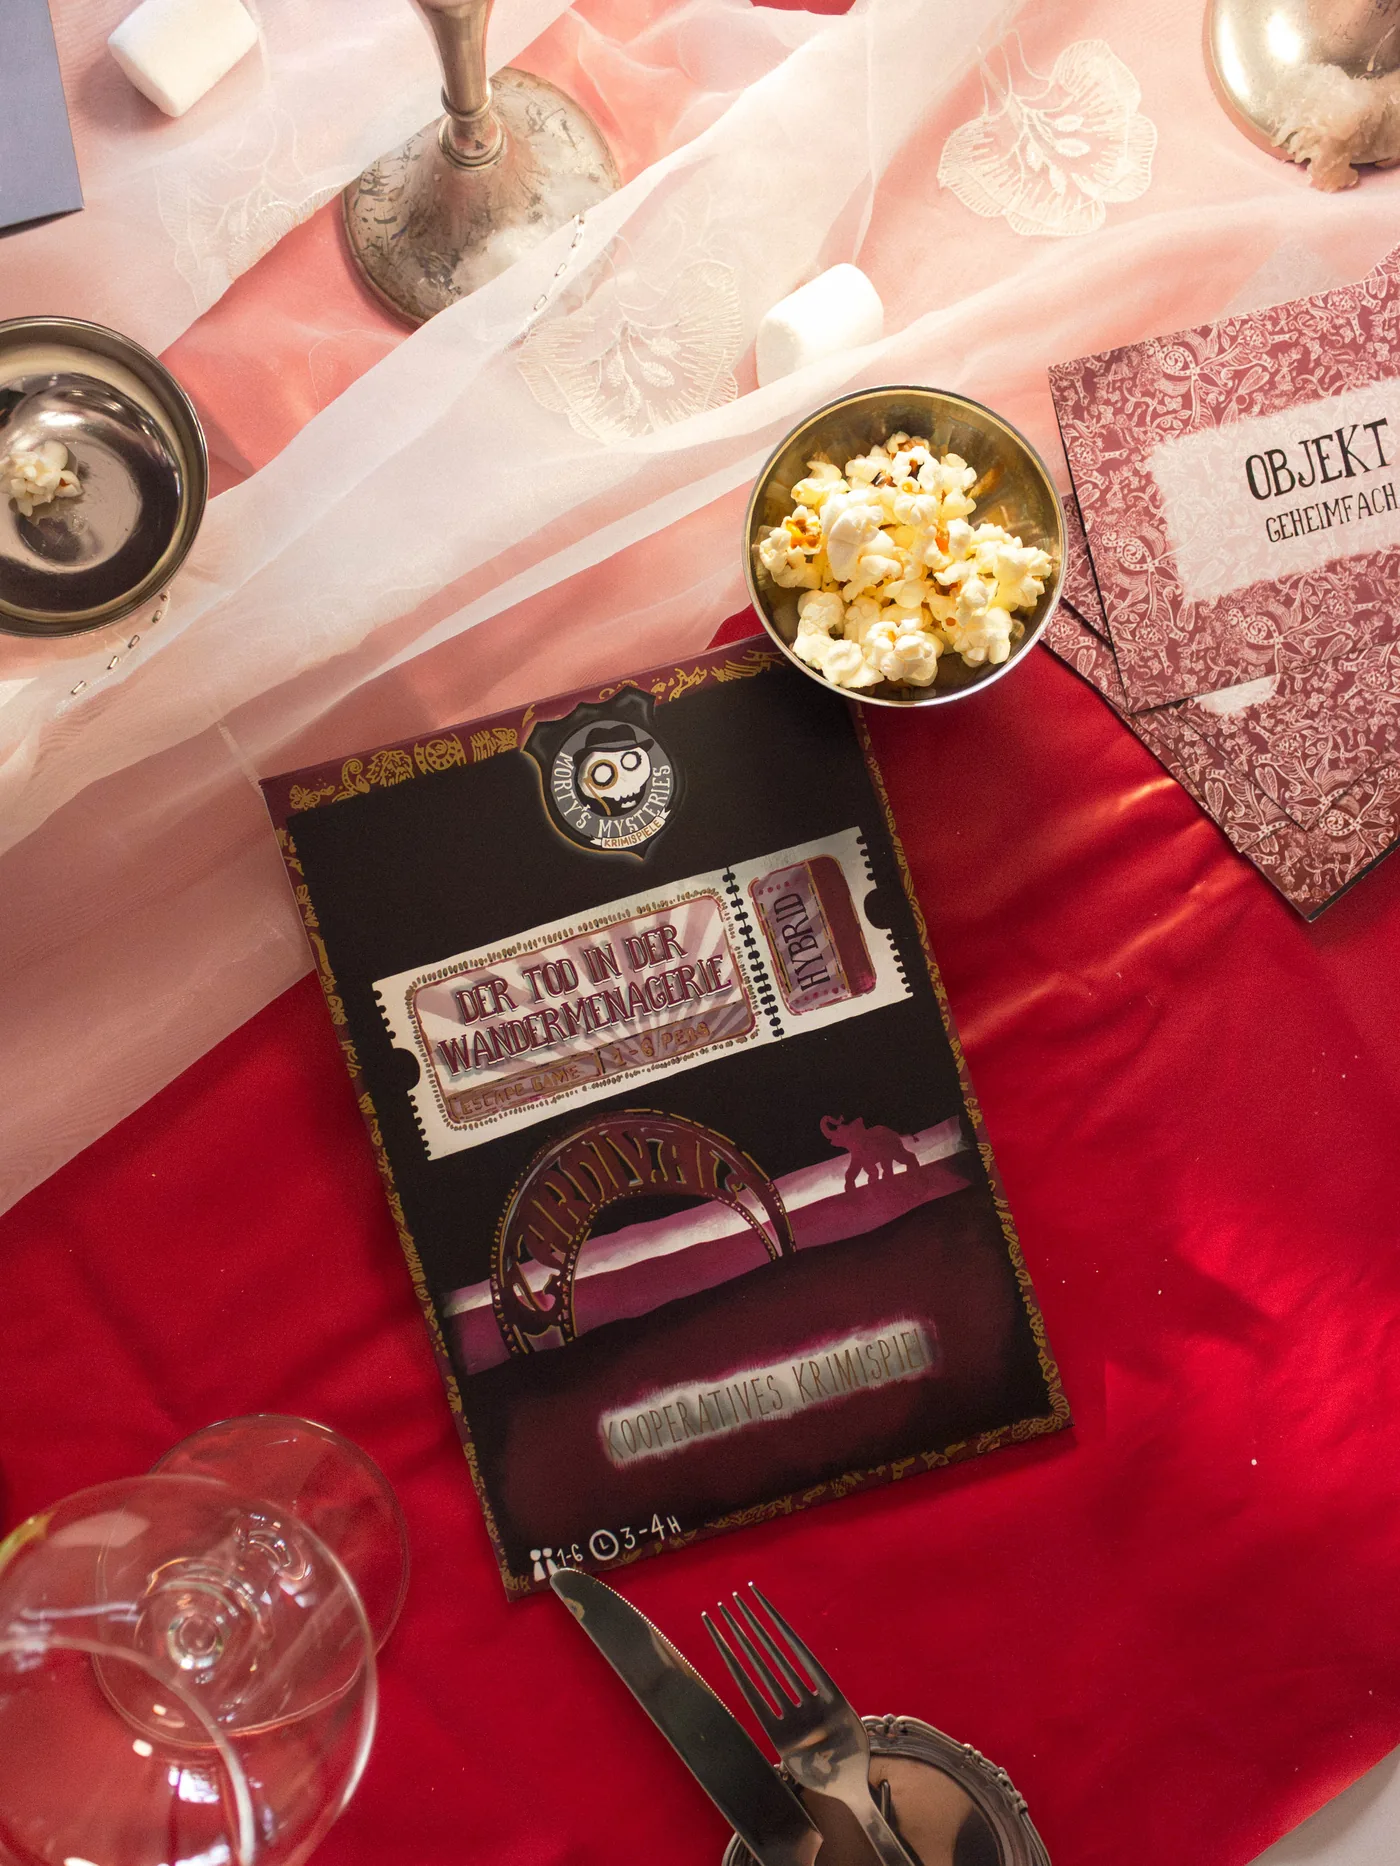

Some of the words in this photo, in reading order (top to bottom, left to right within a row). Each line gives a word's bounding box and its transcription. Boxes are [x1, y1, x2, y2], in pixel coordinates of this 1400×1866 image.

[1245, 417, 1392, 501] OBJEKT
[1265, 482, 1400, 543] GEHEIMFACH
[553, 752, 592, 830] MORTY'S
[597, 765, 671, 838] MYSTERIES
[604, 819, 662, 848] KRIMISPIELE
[456, 979, 519, 1026] DER
[523, 958, 580, 1004] TOD
[583, 942, 623, 986] IN
[625, 924, 688, 973] DER
[773, 893, 831, 992] HYBRID
[437, 954, 732, 1076] WANDERMENAGERIE
[532, 1064, 584, 1092] GAME
[601, 1374, 784, 1460] KOOPERATIVES
[556, 1543, 584, 1567] 1-6
